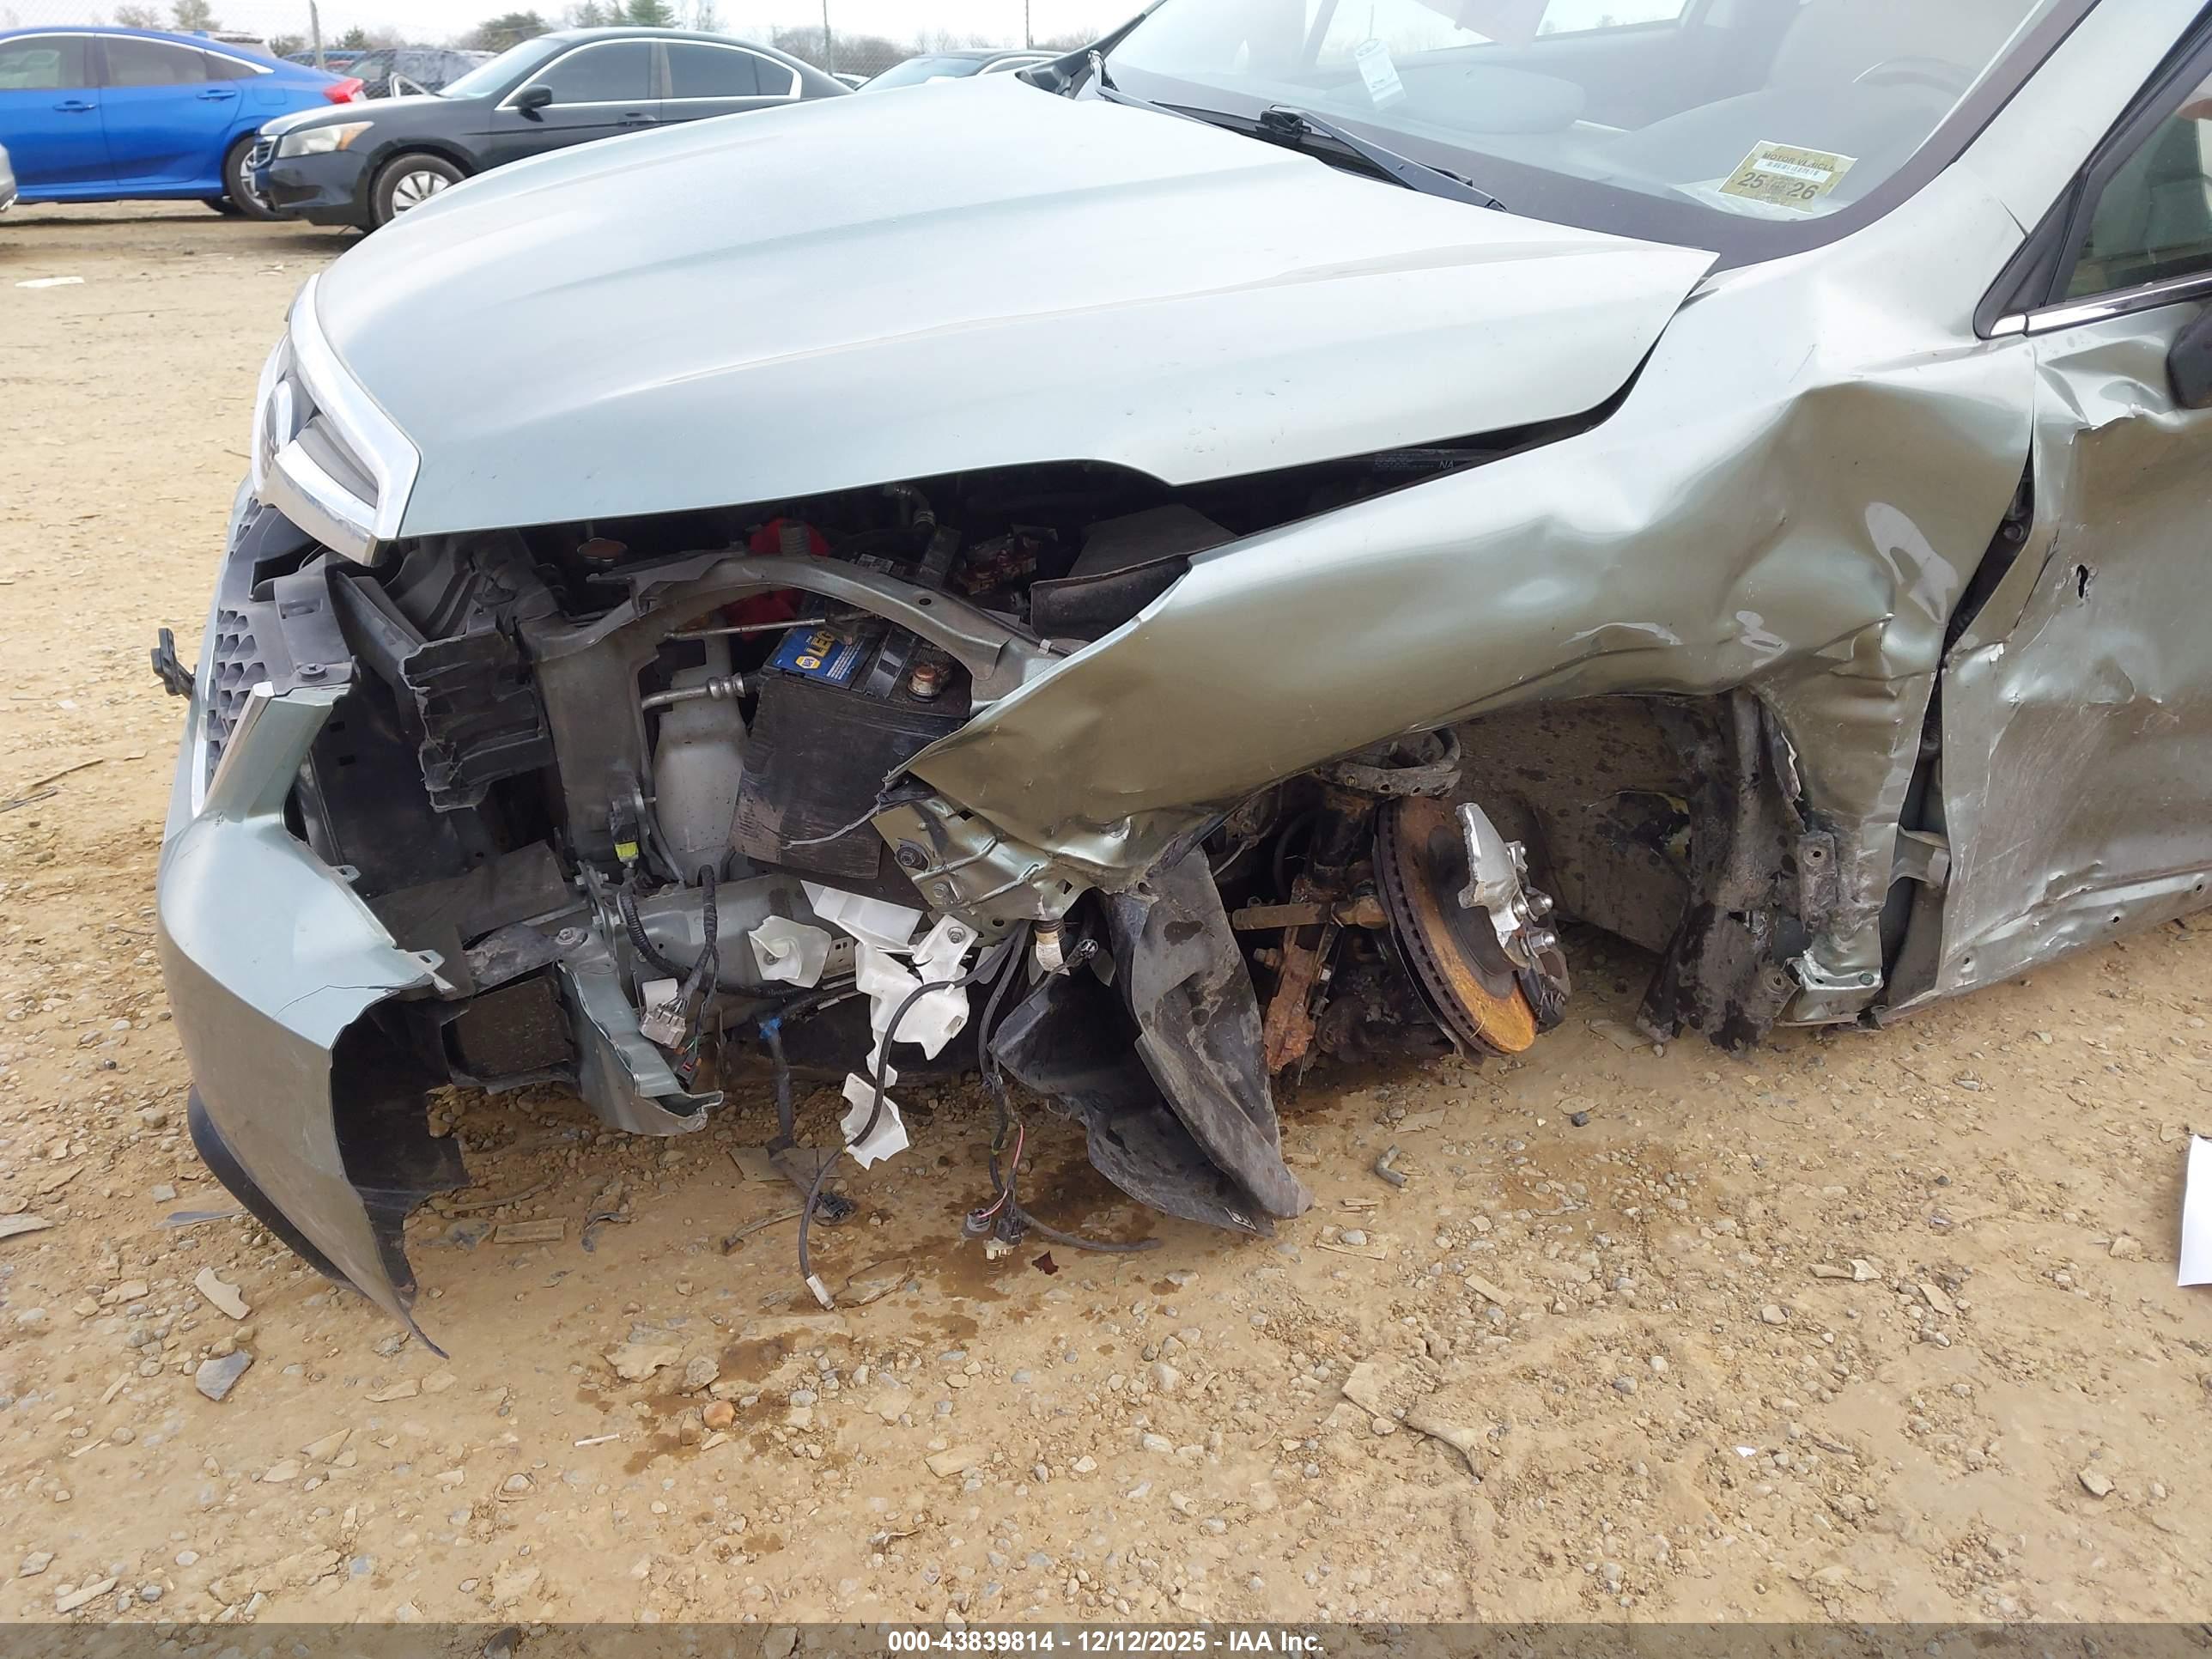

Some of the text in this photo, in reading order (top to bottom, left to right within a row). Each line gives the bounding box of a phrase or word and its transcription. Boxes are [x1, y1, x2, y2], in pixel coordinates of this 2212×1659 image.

[1762, 152, 1796, 163] MOTOR
[1737, 172, 1767, 189] 25
[1788, 182, 1819, 199] 26
